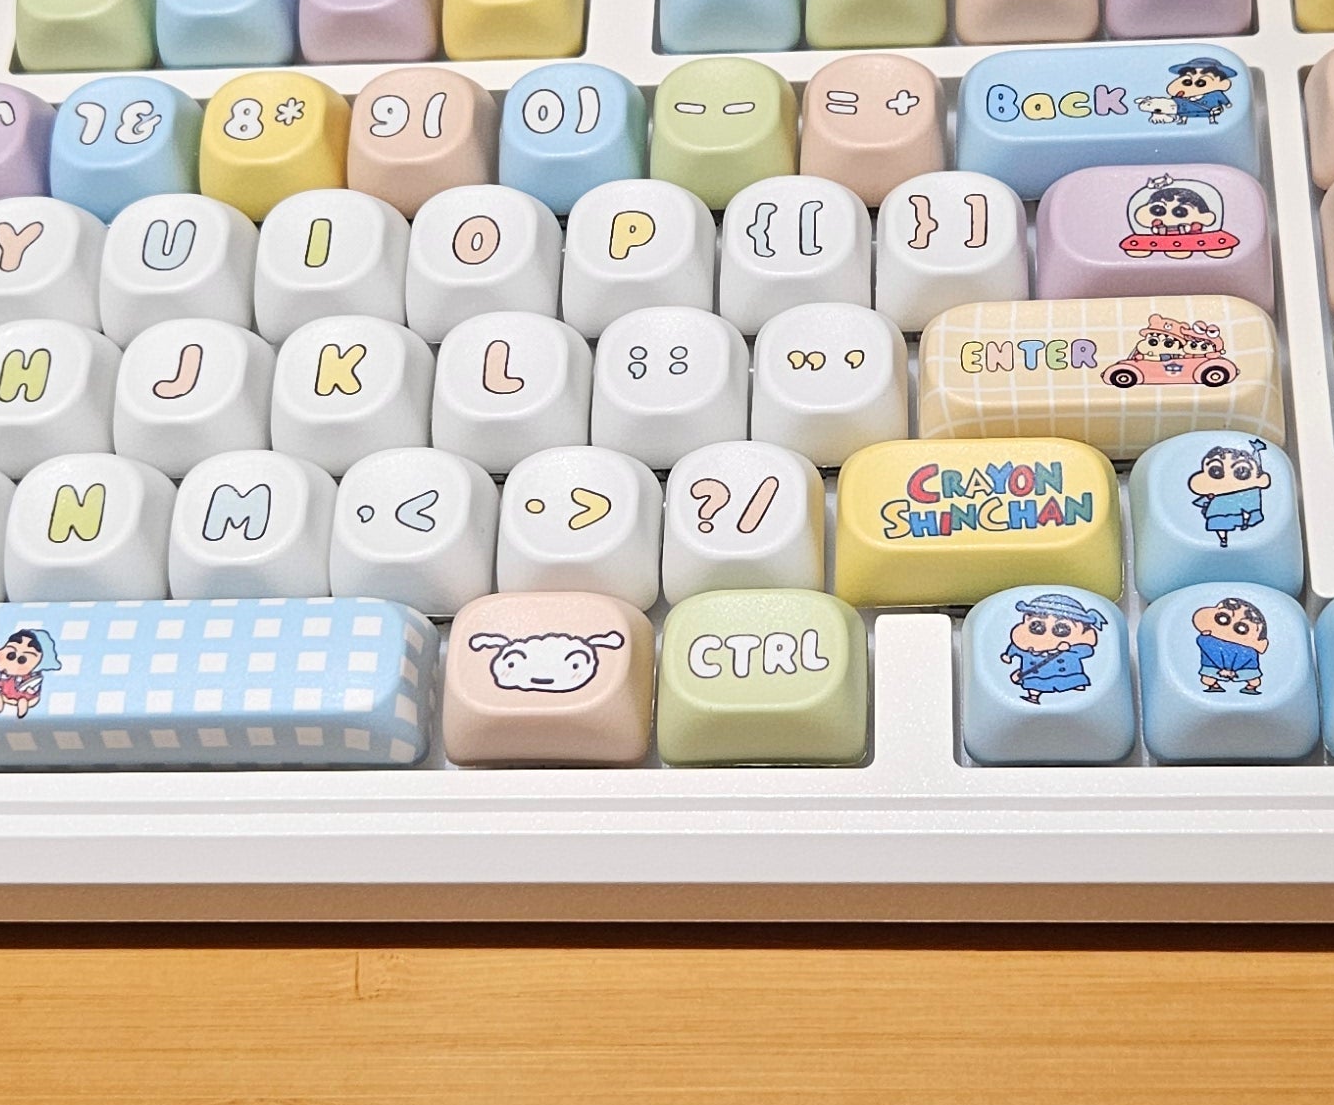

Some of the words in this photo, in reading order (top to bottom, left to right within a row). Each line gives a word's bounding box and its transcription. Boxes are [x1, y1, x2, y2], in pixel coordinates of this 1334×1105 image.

[985, 82, 1130, 123] Back
[141, 218, 197, 272] U
[304, 217, 333, 269] I
[451, 214, 501, 266] O
[609, 210, 656, 261] P
[152, 343, 203, 399] J
[314, 343, 367, 397] K
[482, 339, 525, 395] L
[960, 338, 1098, 375] ENTER
[906, 460, 1064, 504] CRAYON
[47, 483, 107, 544] N
[201, 484, 272, 542] M
[880, 492, 1093, 539] SHINCHAN
[687, 628, 831, 679] CTRL
